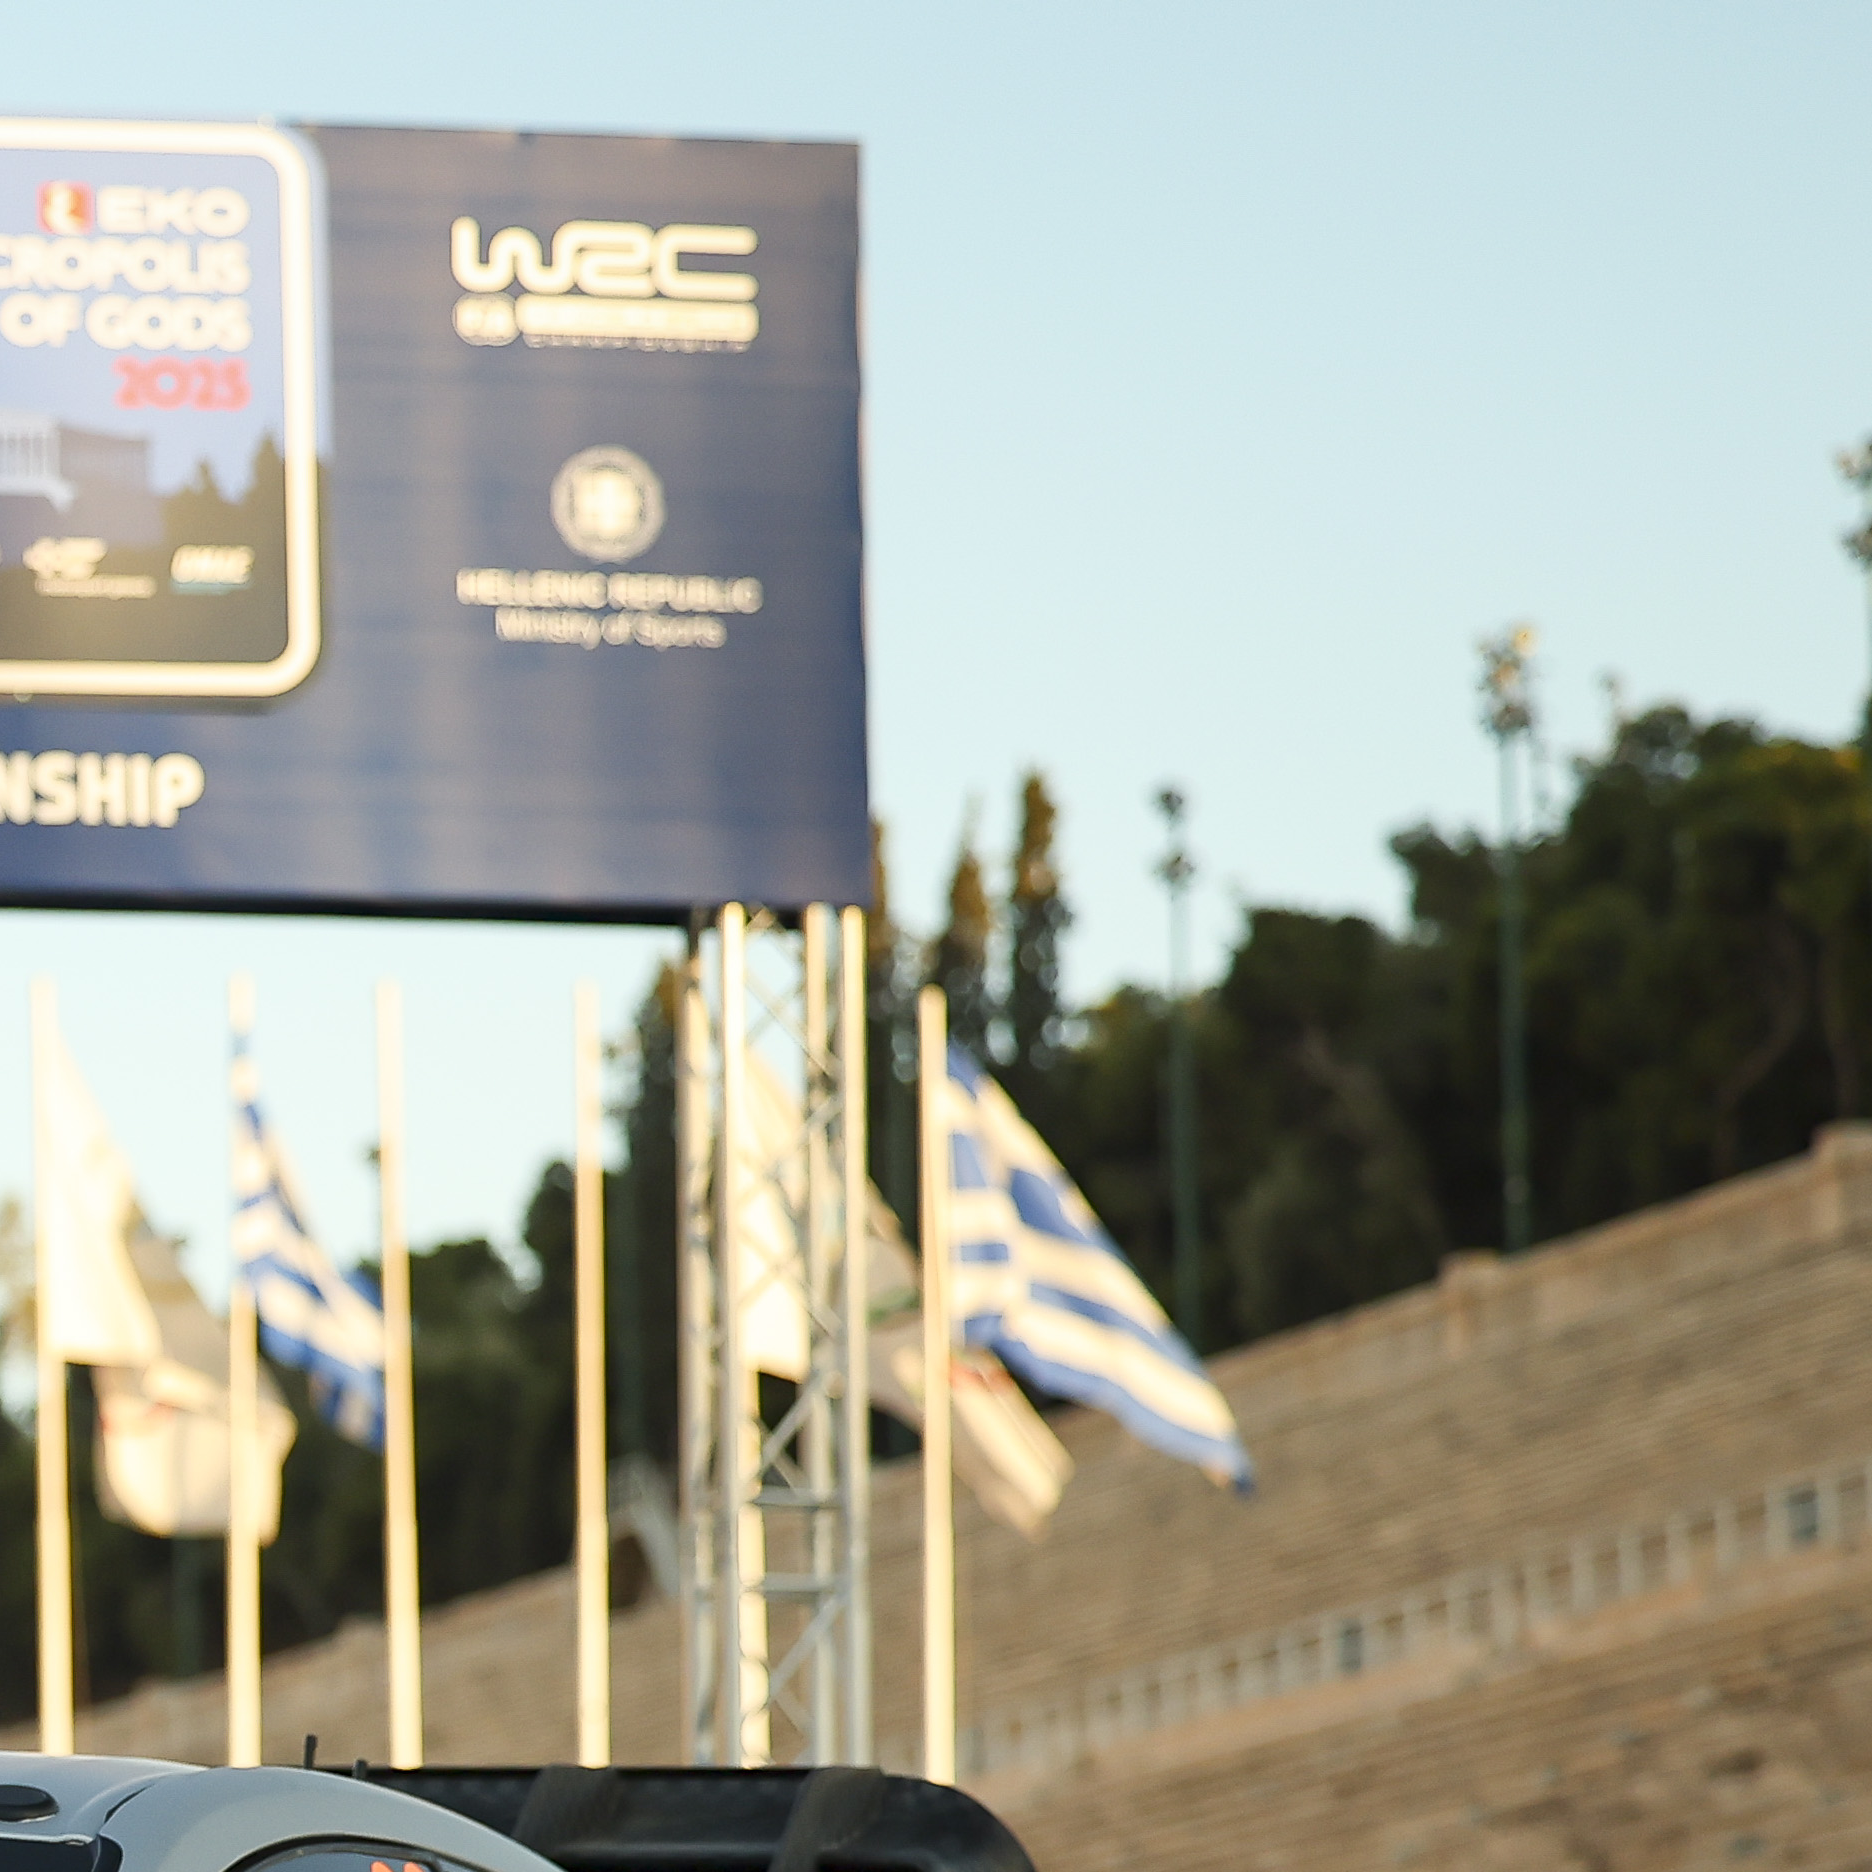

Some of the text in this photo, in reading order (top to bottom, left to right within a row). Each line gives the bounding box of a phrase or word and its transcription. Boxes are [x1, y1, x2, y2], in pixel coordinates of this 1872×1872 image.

[96, 186, 251, 237] EKO
[451, 216, 759, 299] WRC
[85, 295, 252, 352] GODS
